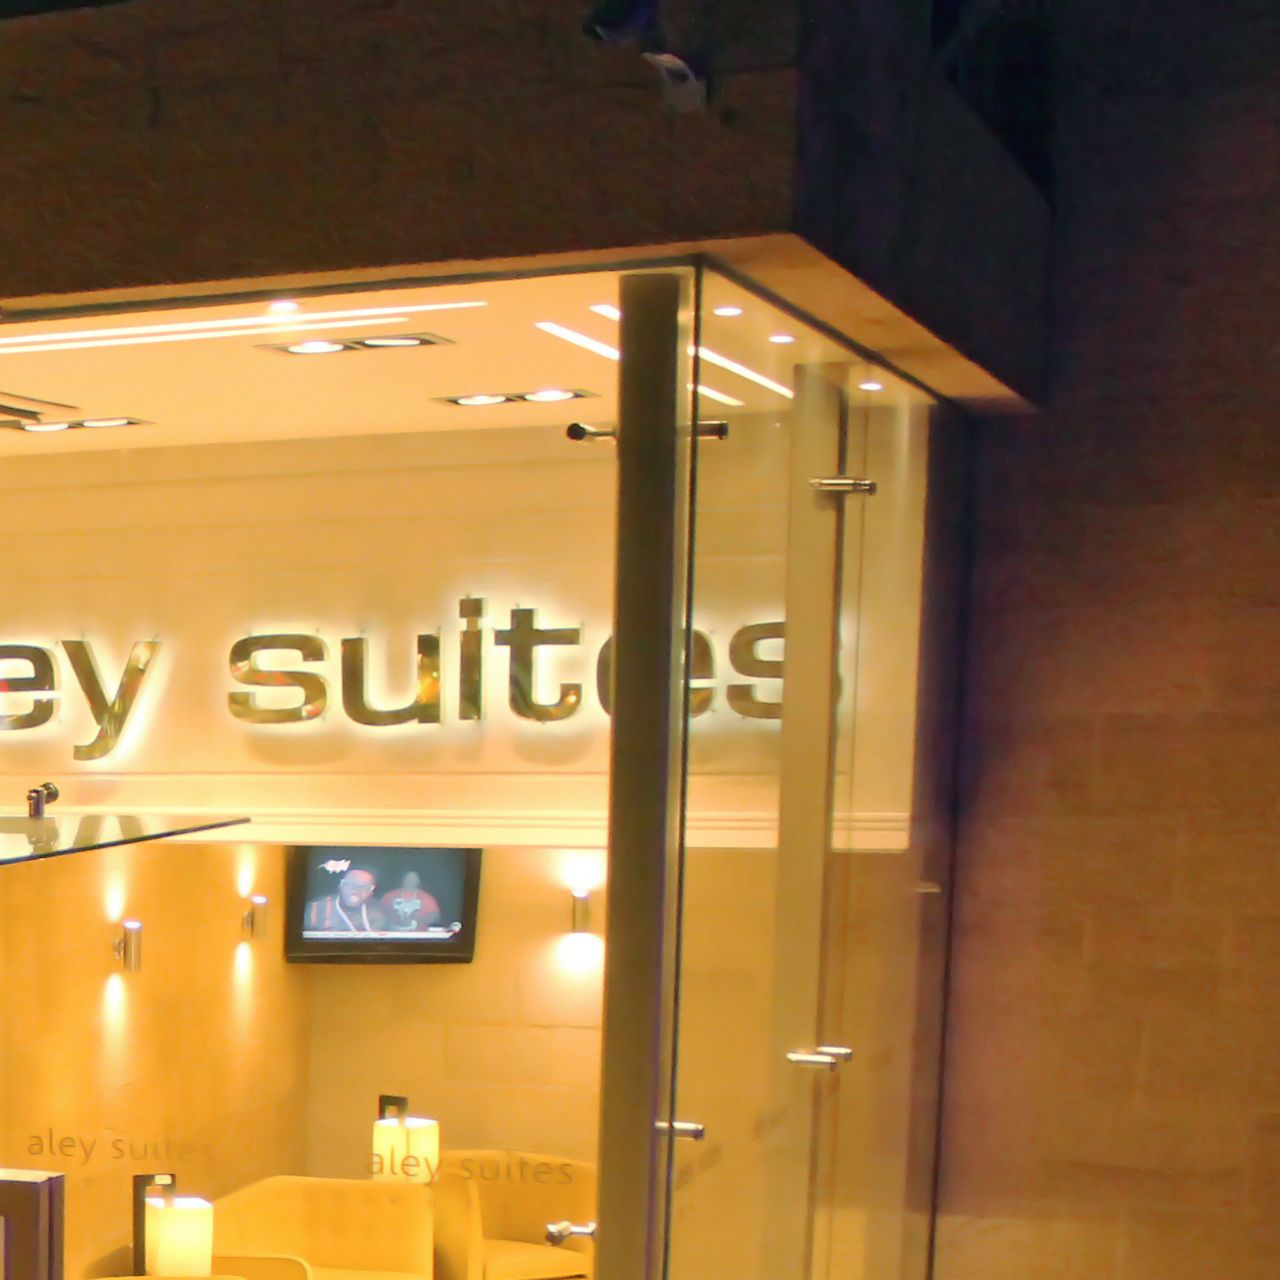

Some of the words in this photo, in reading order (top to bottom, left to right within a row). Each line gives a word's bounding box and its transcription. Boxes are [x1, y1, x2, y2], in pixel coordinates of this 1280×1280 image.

[26, 1126, 97, 1168] aley
[110, 1136, 216, 1165] suites
[370, 1145, 443, 1187] aley
[459, 1150, 576, 1186] suites
